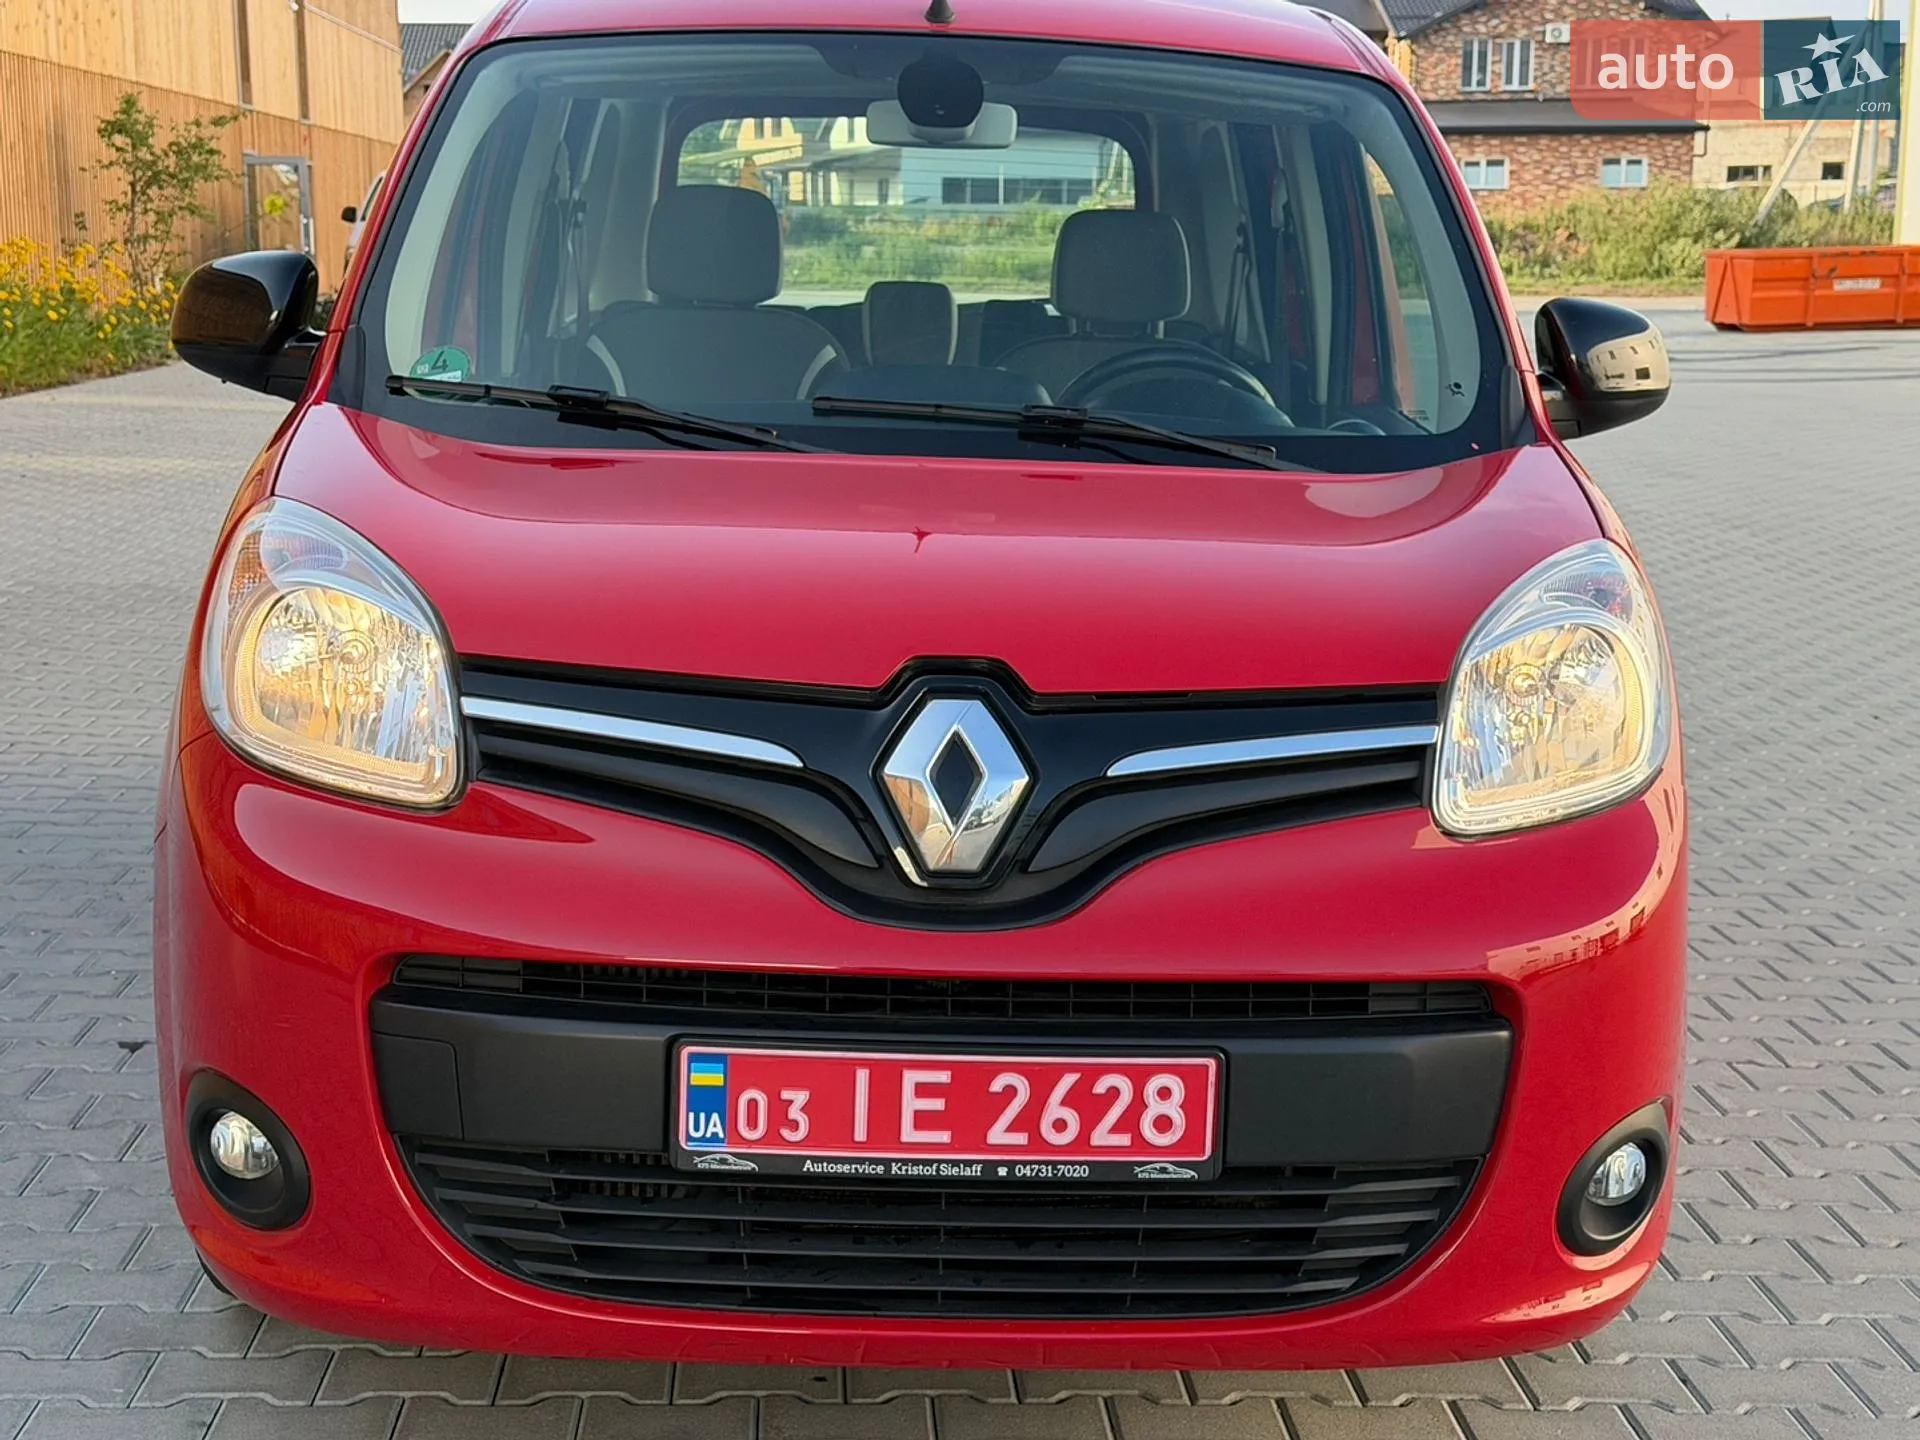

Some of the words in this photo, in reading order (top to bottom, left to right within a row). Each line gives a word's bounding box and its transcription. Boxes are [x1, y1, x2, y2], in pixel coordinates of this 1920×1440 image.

[431, 350, 449, 371] 4
[736, 1089, 810, 1143] 03
[853, 1066, 952, 1144] IE
[986, 1072, 1186, 1147] 2628
[688, 1112, 724, 1139] UA
[802, 1159, 885, 1175] Autoservice
[891, 1162, 937, 1176] Kristof
[939, 1163, 983, 1177] Sielaff
[1014, 1164, 1090, 1178] 04731-7020
